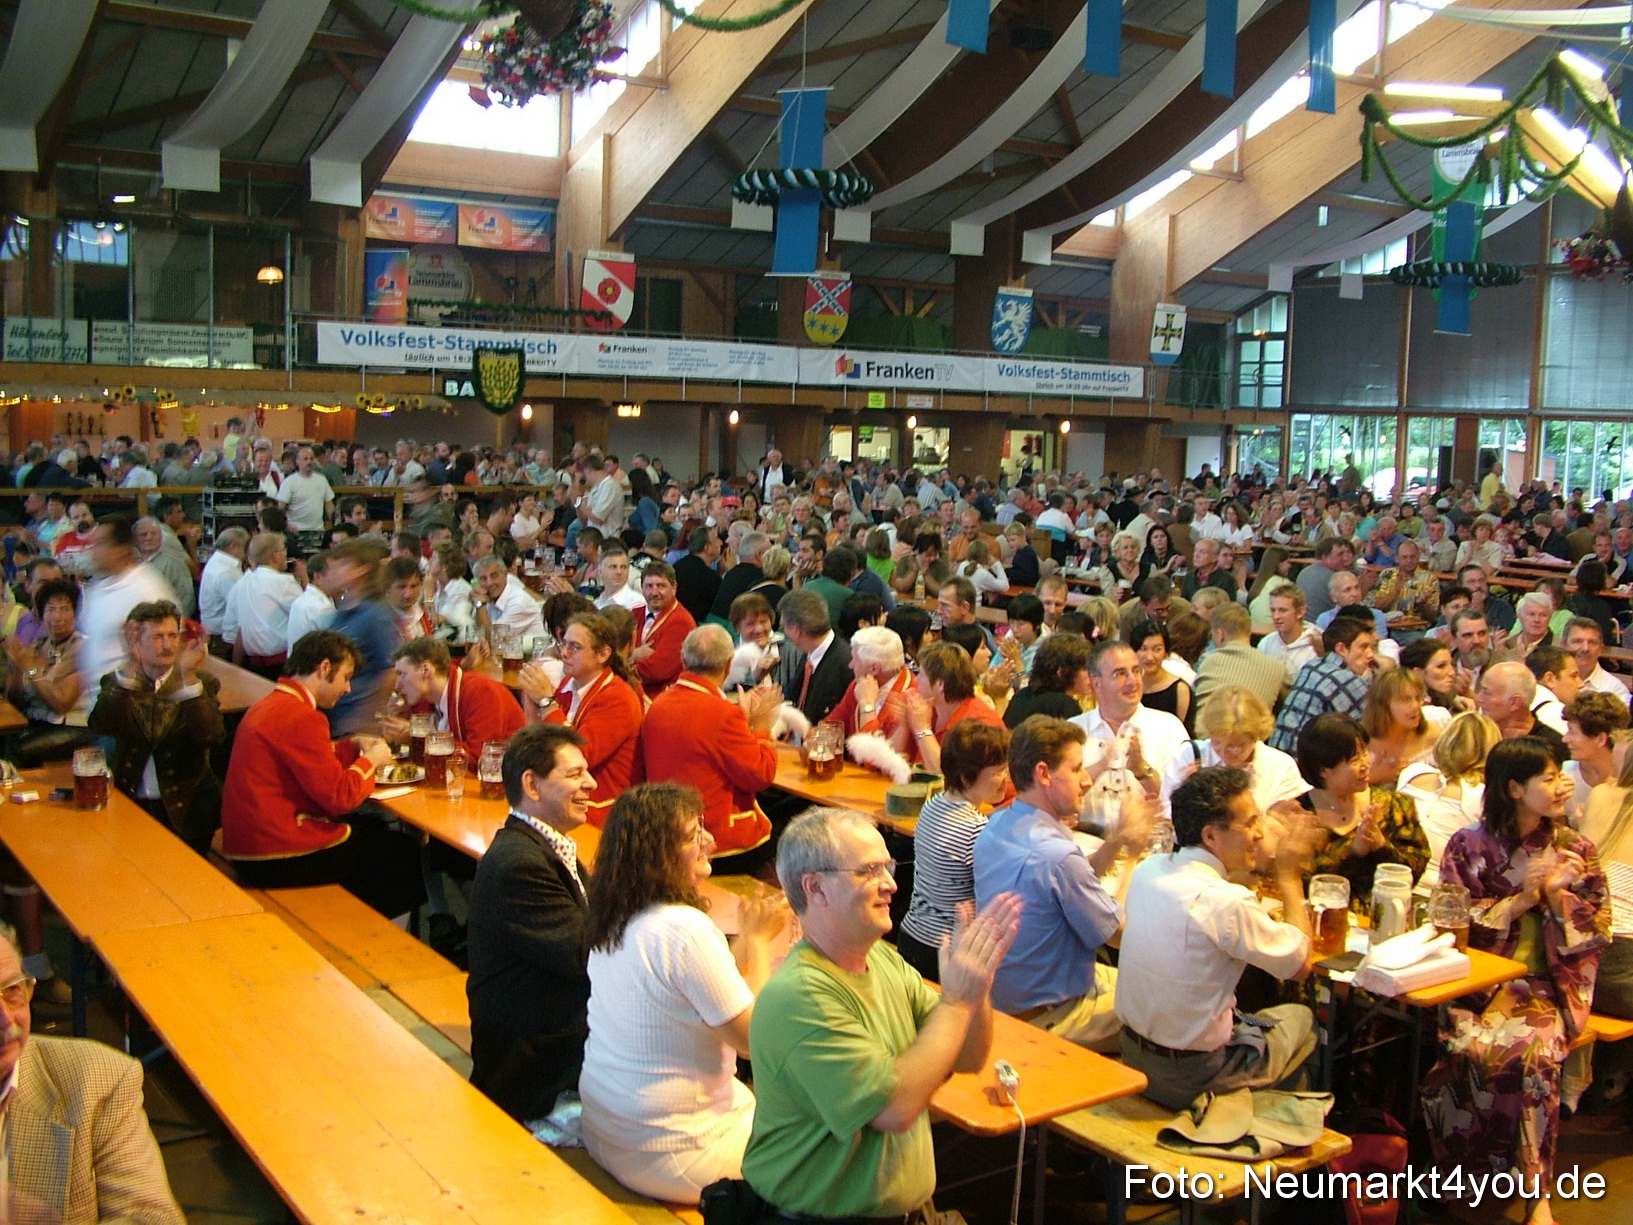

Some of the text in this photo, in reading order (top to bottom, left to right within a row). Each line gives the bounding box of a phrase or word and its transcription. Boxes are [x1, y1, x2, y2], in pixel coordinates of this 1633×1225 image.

[340, 329, 557, 354] Volksfest-Stammtisch
[404, 353, 434, 363] täglich
[453, 355, 473, 363] 18:2
[997, 363, 1131, 382] Volksfest-Stammtisch
